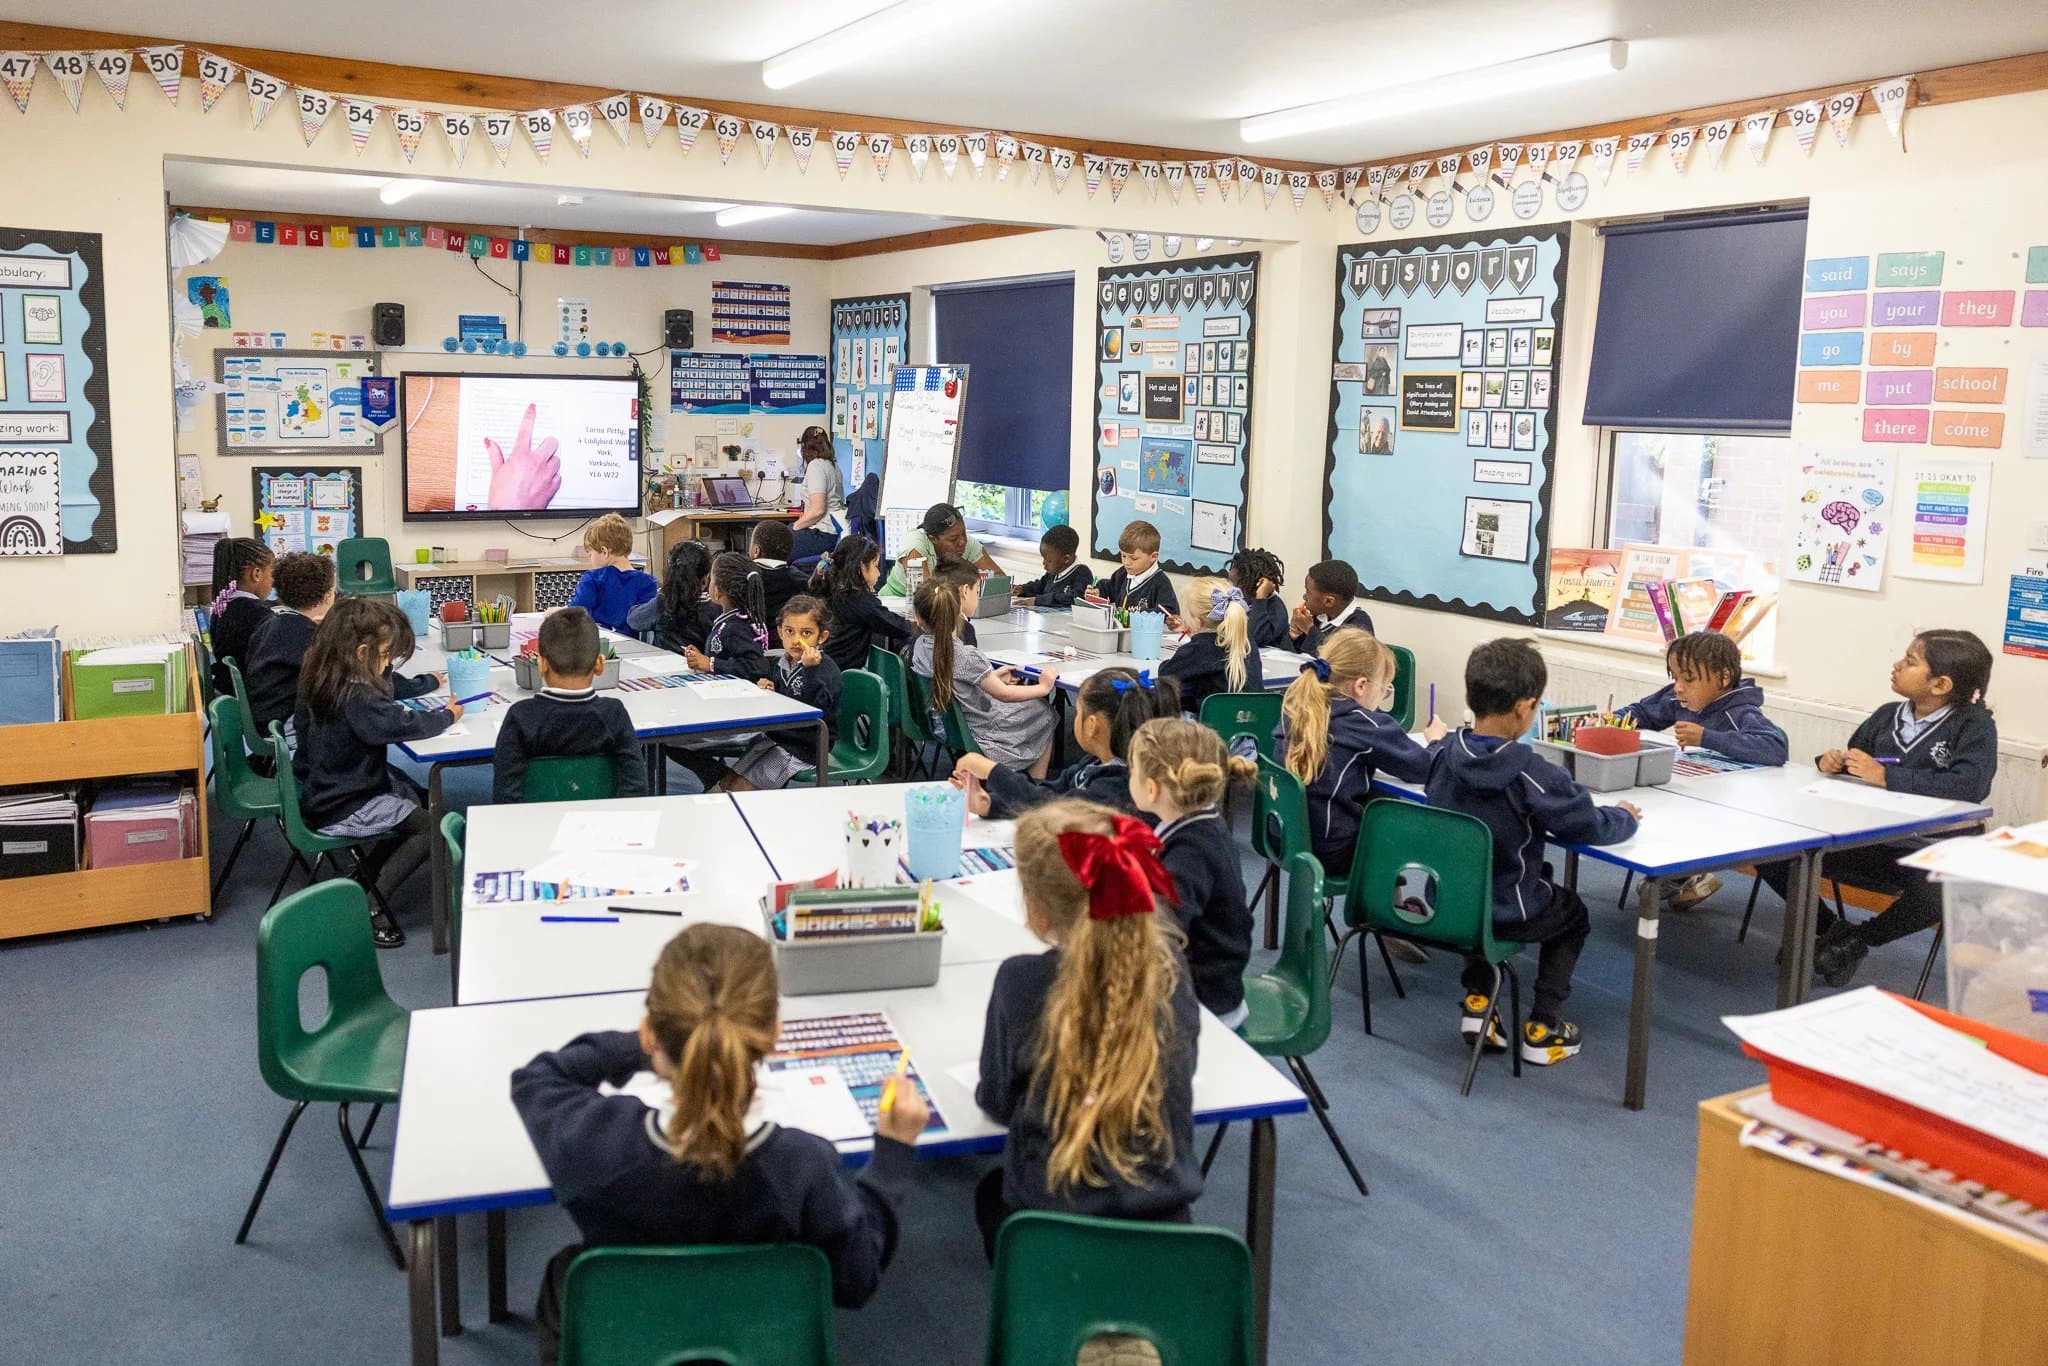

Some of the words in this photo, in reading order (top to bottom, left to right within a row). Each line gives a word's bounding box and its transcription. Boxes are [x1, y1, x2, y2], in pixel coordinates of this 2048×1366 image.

[1, 58, 32, 77] 47
[53, 56, 83, 74] 48
[98, 57, 127, 75] 49
[149, 53, 179, 72] 50
[202, 58, 229, 84] 51
[250, 77, 278, 101] 52
[301, 94, 328, 115] 53
[349, 105, 374, 125] 54
[397, 114, 423, 131] 55
[446, 118, 470, 135] 56
[488, 119, 511, 136] 57
[528, 116, 552, 133] 58
[567, 110, 590, 129] 59
[606, 101, 628, 119] 60
[643, 102, 665, 119] 61
[680, 110, 702, 128] 62
[717, 121, 739, 137] 63
[755, 125, 777, 141] 64
[792, 132, 811, 147] 65
[836, 135, 855, 151] 66
[871, 139, 889, 154] 67
[909, 138, 927, 153] 68
[939, 138, 957, 153] 69
[968, 137, 986, 152] 70
[1026, 147, 1042, 162] 72
[1056, 155, 1071, 169] 73
[1088, 160, 1104, 175] 74
[1113, 163, 1128, 177] 75
[1142, 164, 1158, 178] 76
[1166, 167, 1182, 180] 77
[1193, 165, 1208, 179] 78
[1217, 162, 1233, 177] 79
[1240, 164, 1255, 179] 80
[1264, 171, 1278, 185] 81
[1292, 175, 1307, 188] 82
[1320, 174, 1335, 187] 83
[1345, 169, 1358, 183] 84
[1368, 169, 1382, 183] 85
[1386, 165, 1401, 179] 86
[1411, 164, 1427, 178] 87
[1441, 158, 1457, 173] 88
[1471, 149, 1489, 166] 89
[1501, 147, 1518, 162] 90
[1530, 147, 1546, 161] 91
[1558, 146, 1577, 160] 92
[1629, 137, 1651, 152] 94
[1671, 131, 1691, 148] 95
[1707, 124, 1728, 141] 96
[1793, 108, 1816, 127] 98
[1830, 96, 1855, 117] 99
[1879, 86, 1904, 104] 100
[236, 225, 246, 234] D
[261, 228, 269, 237] E
[285, 230, 292, 240] F
[310, 230, 320, 240] G
[363, 233, 369, 243] I
[387, 233, 393, 243] J
[409, 232, 418, 242] K
[431, 230, 438, 241] L
[450, 236, 462, 247] M
[473, 239, 483, 250] N
[494, 242, 505, 253] O
[517, 244, 525, 255] P
[558, 248, 566, 259] R
[579, 250, 586, 260] S
[600, 252, 608, 261] T
[617, 252, 626, 261] U
[637, 253, 646, 262] V
[655, 251, 668, 261] W
[689, 251, 697, 261] Y
[708, 247, 716, 257] Z
[1355, 256, 1530, 285] History
[1820, 267, 1853, 282] said
[1890, 263, 1927, 280] says
[1102, 278, 1250, 302] Geography
[838, 309, 900, 326] Phonics
[1820, 306, 1848, 323] you
[1886, 302, 1926, 321] your
[1958, 300, 1998, 320] they
[856, 343, 863, 355] ie
[1821, 343, 1841, 360] go
[1892, 340, 1912, 358] by
[1817, 380, 1841, 393] me
[1885, 382, 1913, 397] put
[1943, 376, 1998, 391] school
[26, 423, 60, 433] work:
[1874, 420, 1916, 435] there
[1944, 424, 1990, 437] come
[24, 501, 49, 513] SOON!
[2026, 567, 2044, 576] Fire
